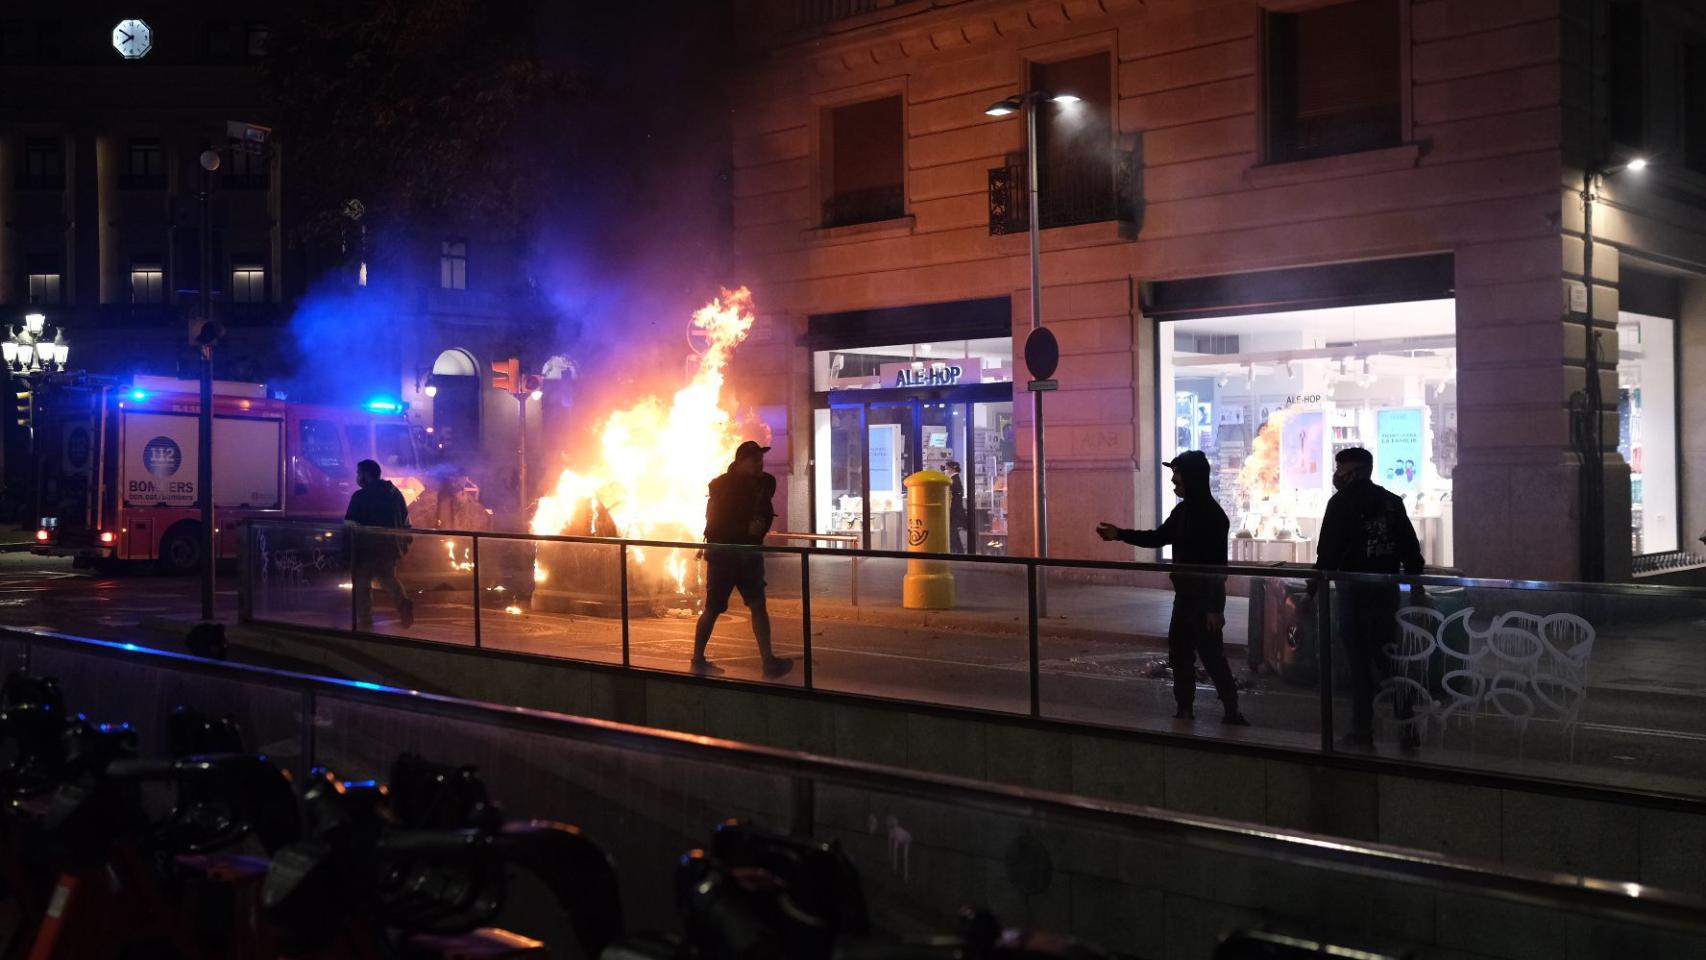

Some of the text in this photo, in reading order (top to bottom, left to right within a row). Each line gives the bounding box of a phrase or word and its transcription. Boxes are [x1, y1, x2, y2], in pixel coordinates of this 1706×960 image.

[896, 366, 962, 387] ALE-HOP
[150, 447, 175, 462] 112
[129, 481, 194, 493] BOMERS
